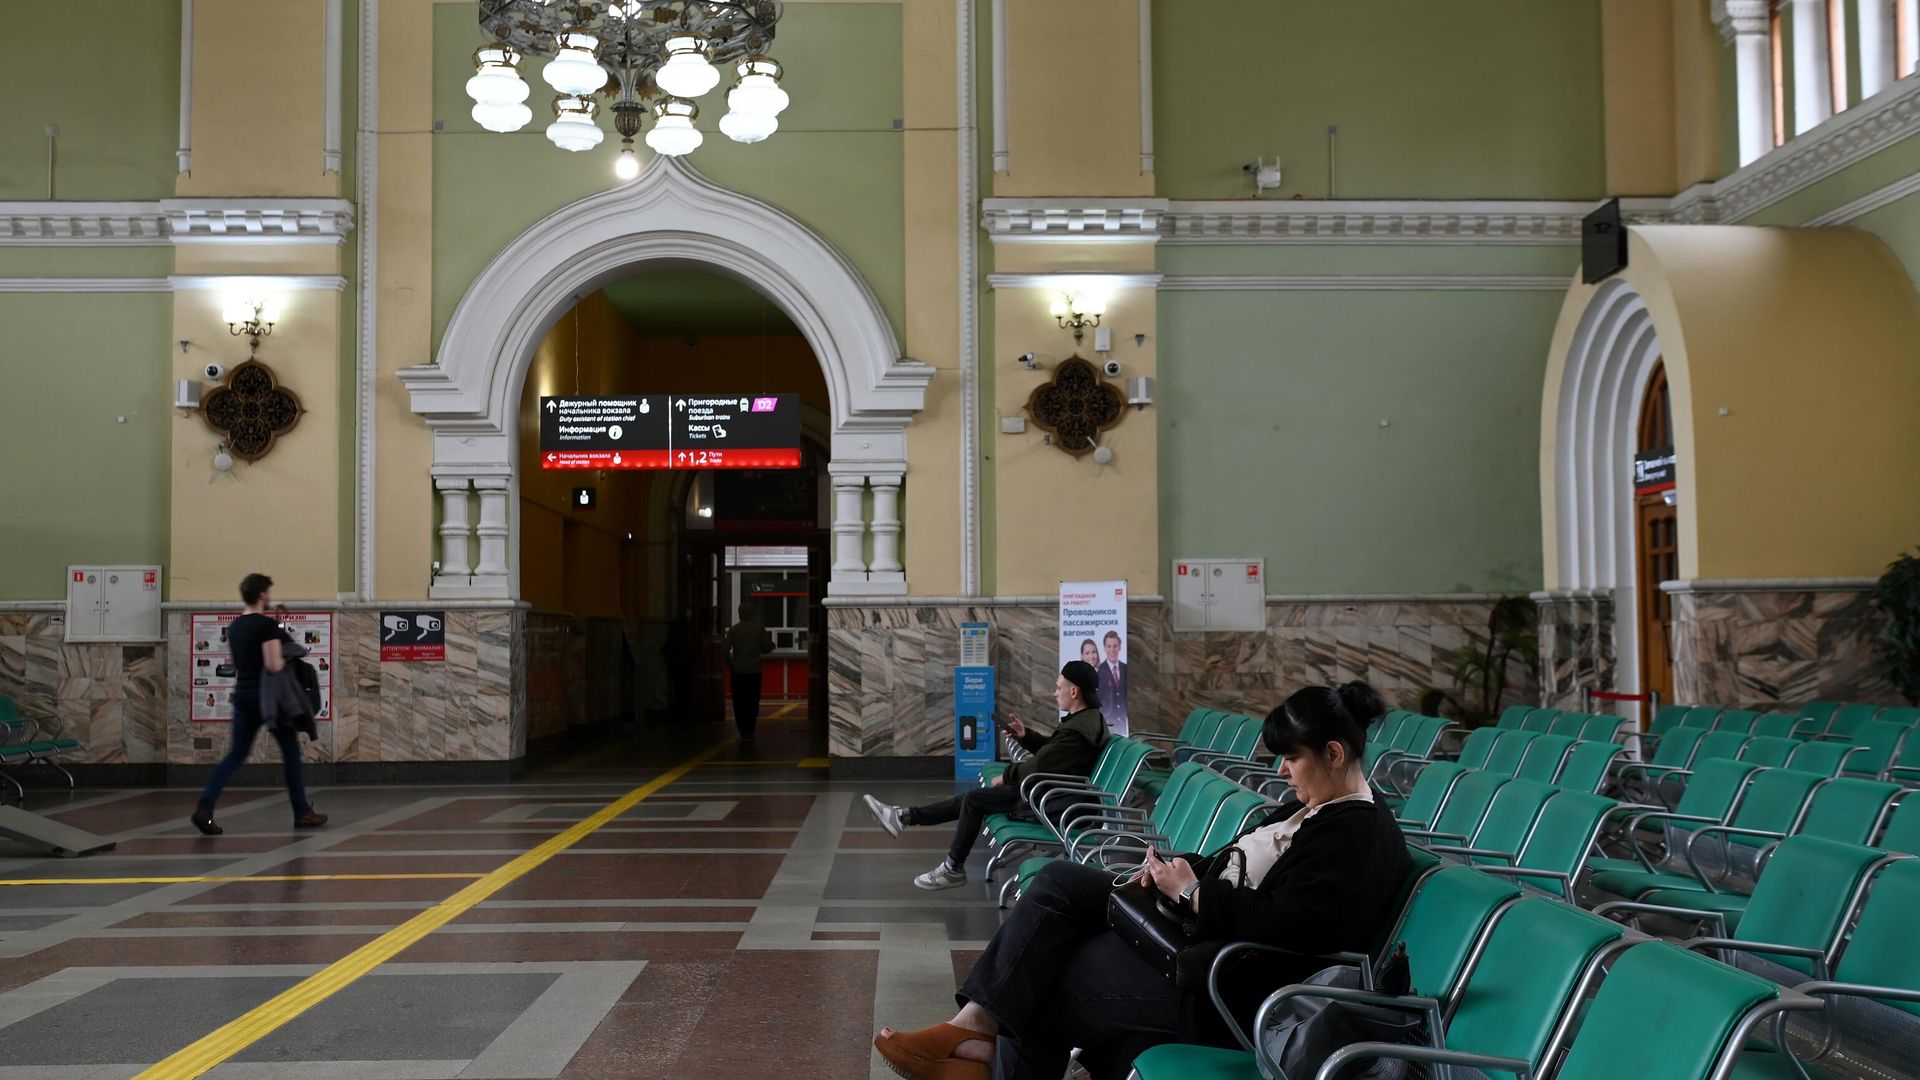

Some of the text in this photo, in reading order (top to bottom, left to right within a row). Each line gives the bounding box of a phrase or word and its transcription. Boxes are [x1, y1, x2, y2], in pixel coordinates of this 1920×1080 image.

[559, 399, 637, 409] Дежурный помощник
[688, 399, 738, 407] Пригородные
[757, 400, 772, 410] D2
[559, 426, 607, 434] Информация
[688, 424, 710, 432] Кассы
[689, 452, 707, 464] 1,2
[1063, 608, 1117, 617] Проводников
[1063, 619, 1118, 627] пассажирских
